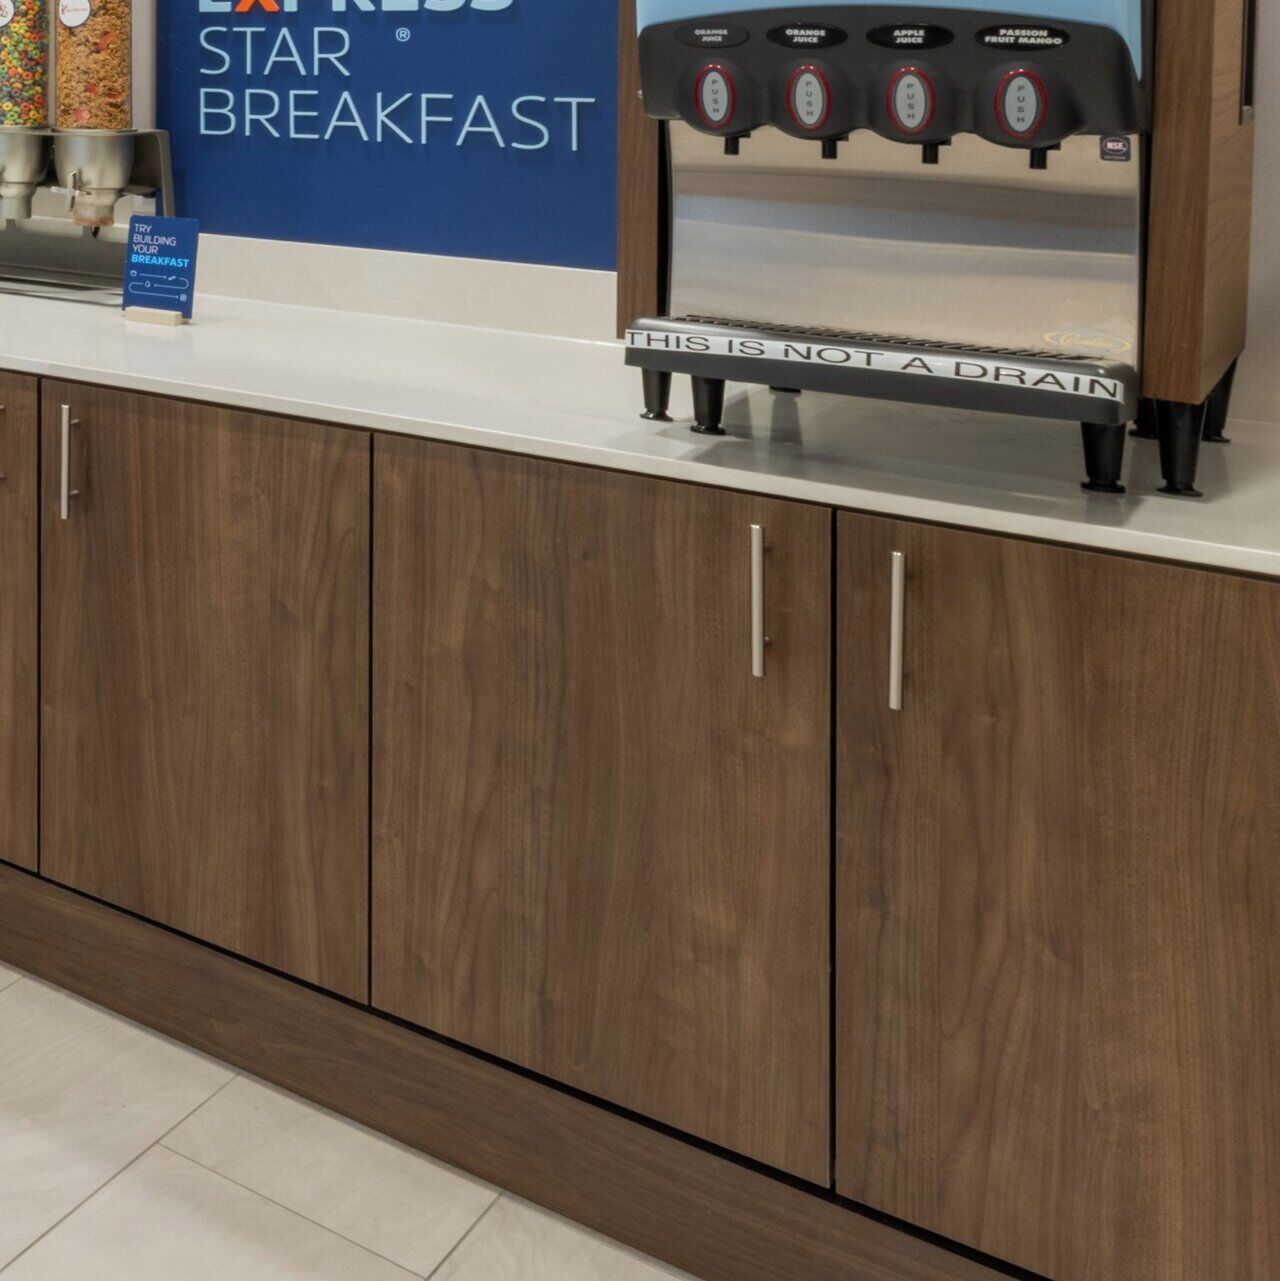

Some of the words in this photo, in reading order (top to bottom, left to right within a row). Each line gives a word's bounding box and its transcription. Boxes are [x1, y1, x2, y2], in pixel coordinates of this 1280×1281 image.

[694, 28, 729, 36] ORANGE
[785, 28, 826, 37] ORANGE
[893, 29, 925, 37] APPLE
[999, 29, 1048, 37] PASSION
[1017, 36, 1063, 44] MANGO
[198, 26, 351, 76] STAR
[199, 87, 597, 152] BREAKFAST
[134, 223, 152, 233] TRY
[133, 233, 177, 246] BUILDING
[132, 244, 159, 254] YOUR
[131, 254, 190, 268] BREAKFAST
[627, 331, 710, 352] THIS
[728, 339, 765, 356] IS
[783, 343, 884, 366] NOT
[901, 356, 934, 373] A
[954, 361, 1118, 398] DRAIN
